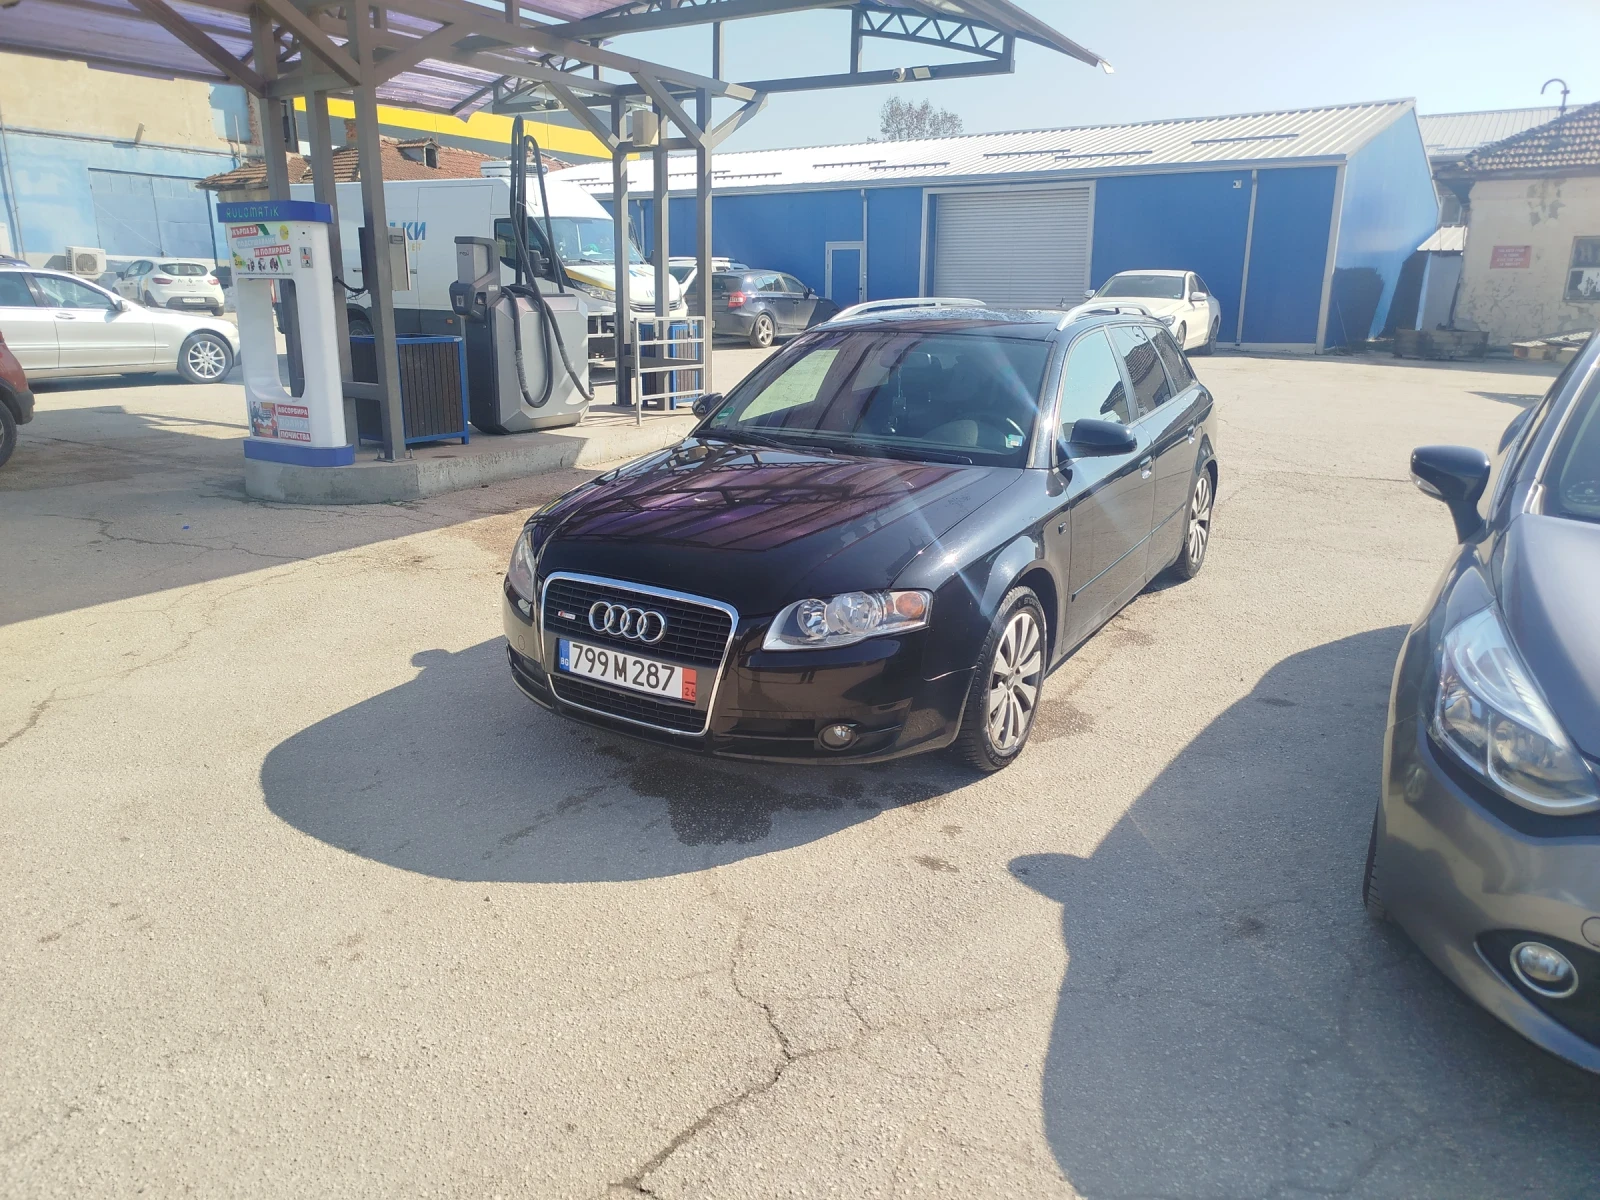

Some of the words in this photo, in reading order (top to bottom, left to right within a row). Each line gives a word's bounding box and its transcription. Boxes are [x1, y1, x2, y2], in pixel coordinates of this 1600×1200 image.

[232, 228, 249, 236] КЪРПА
[260, 246, 290, 255] ПОЛИРАНЕ
[278, 407, 308, 415] АБСОРБИРА
[280, 419, 309, 428] ПОЛИРА
[281, 431, 311, 440] ПОЧИСТВА
[560, 657, 569, 667] BG
[572, 643, 609, 677] 799
[613, 654, 627, 683] M
[632, 659, 675, 691] 287
